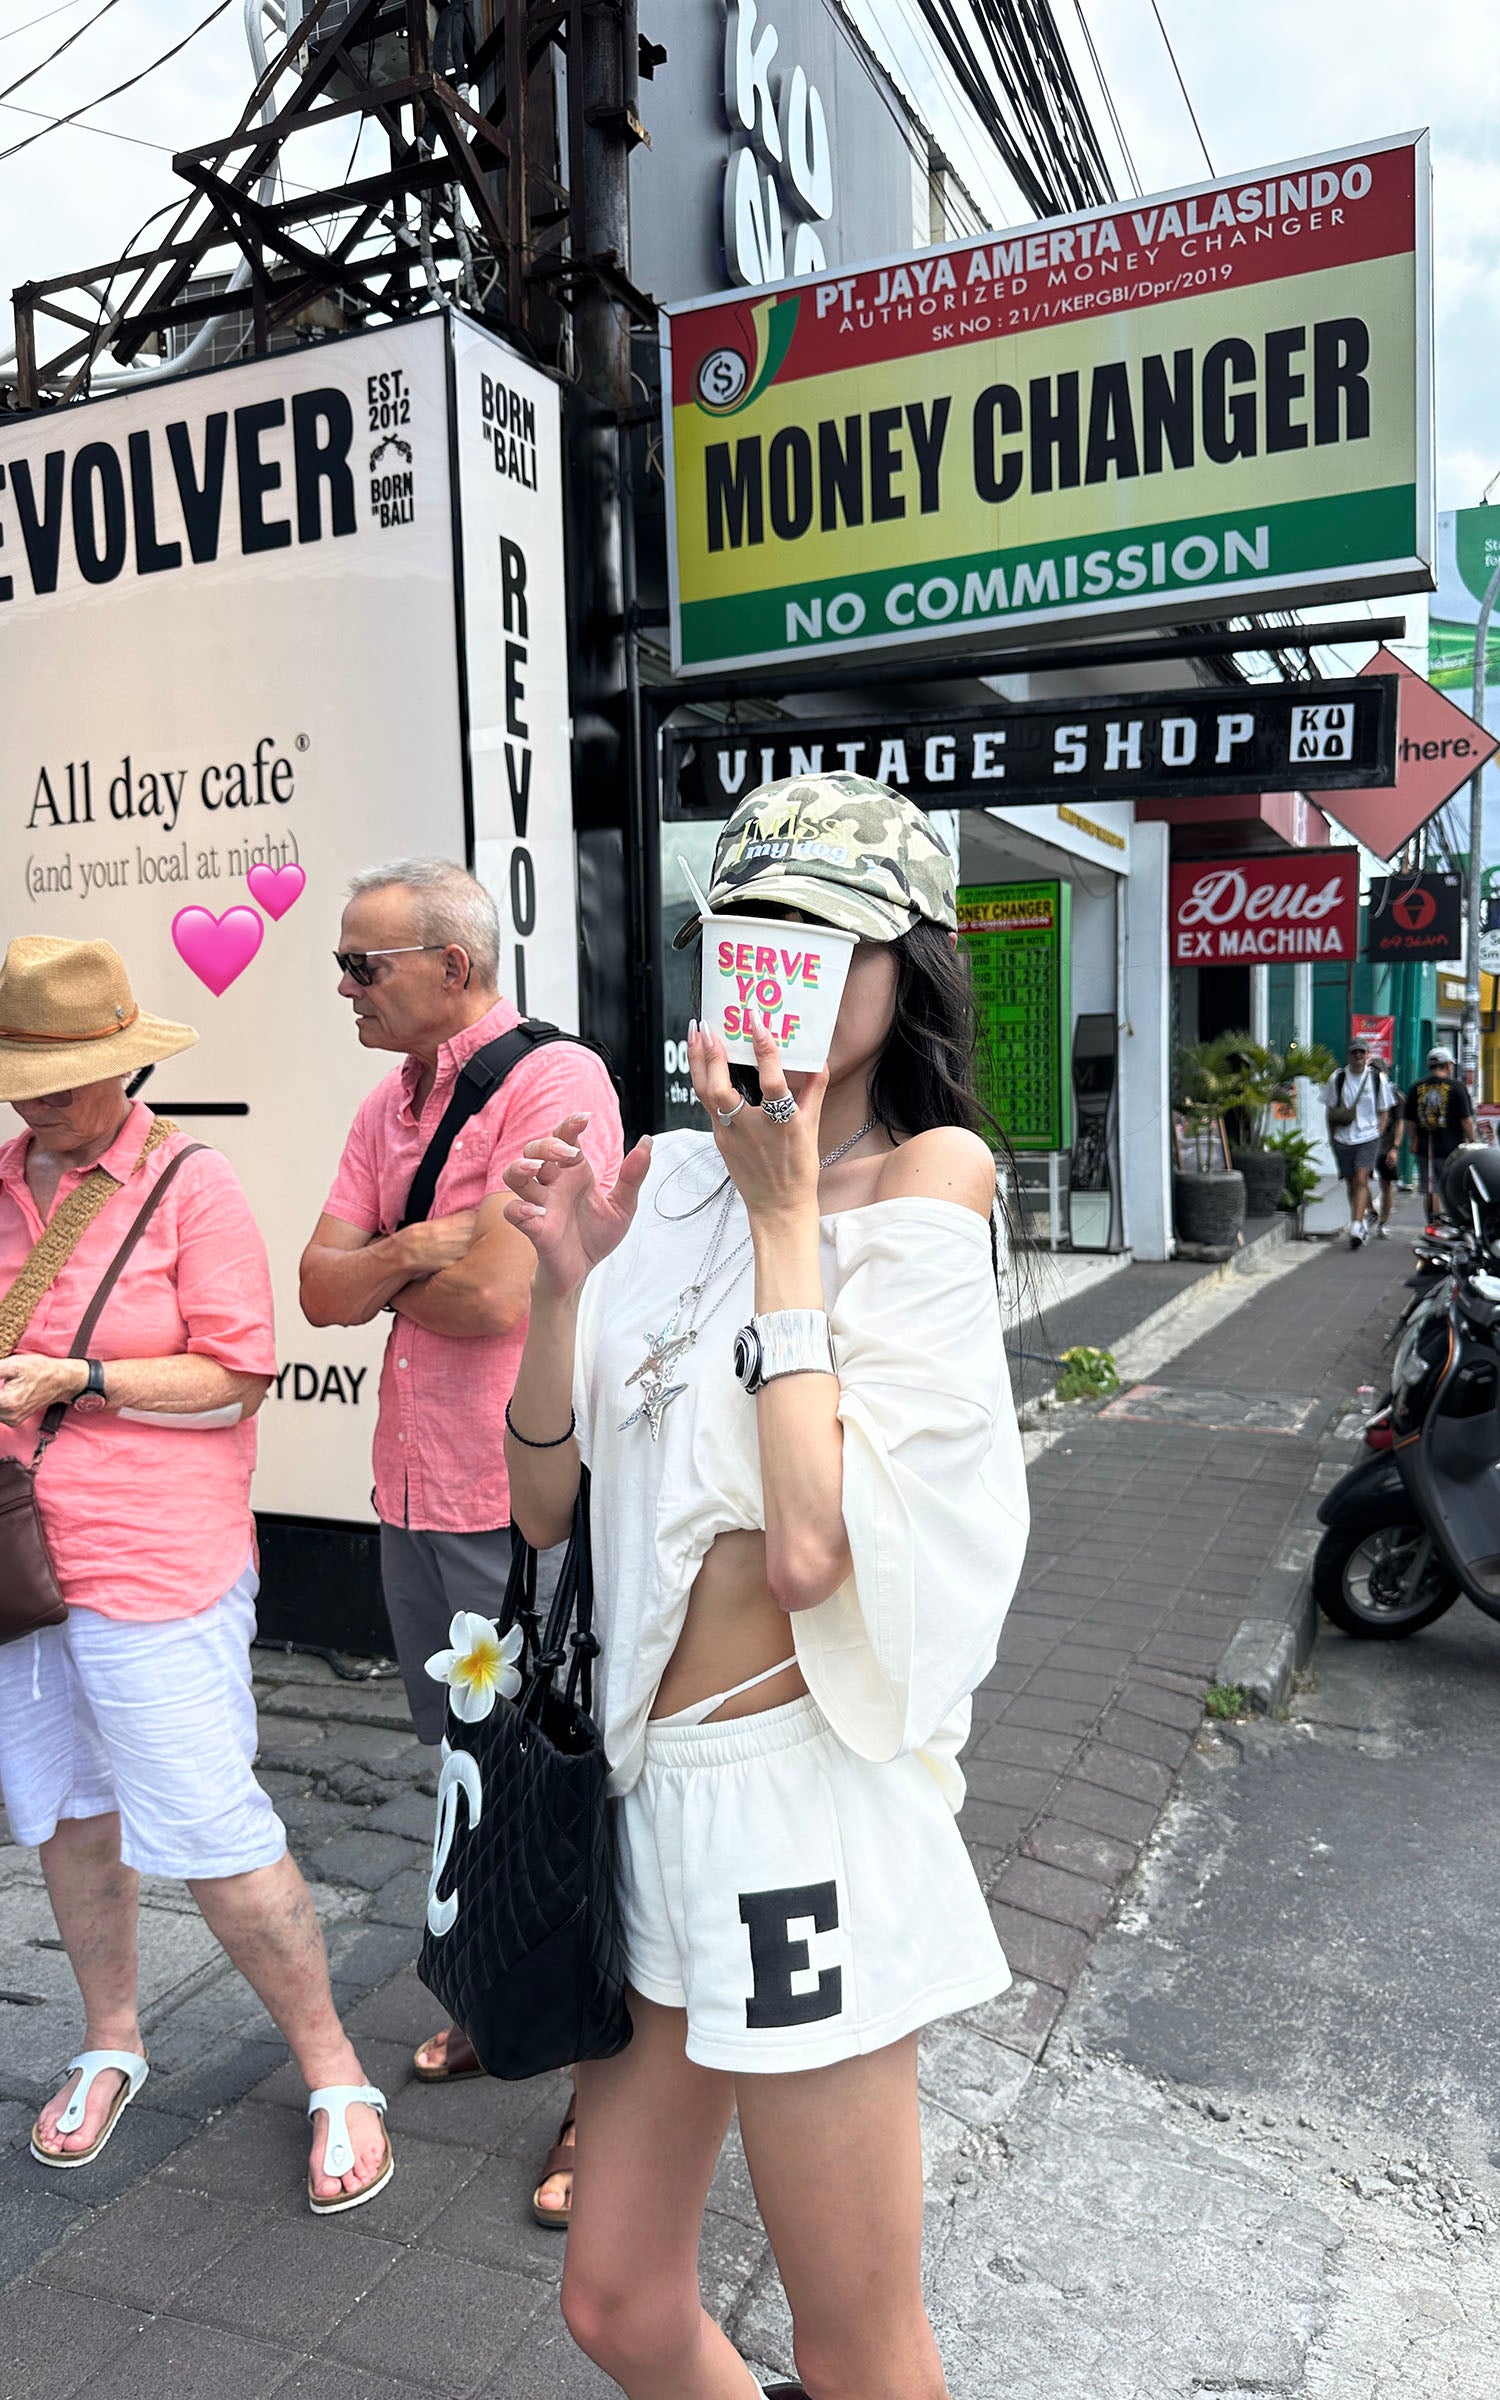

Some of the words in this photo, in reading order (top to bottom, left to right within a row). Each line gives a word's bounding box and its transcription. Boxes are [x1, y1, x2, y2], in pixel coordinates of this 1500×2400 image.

[816, 280, 864, 319] PT.
[874, 258, 956, 306] JAYA
[966, 220, 1121, 285] AMERTA
[1132, 163, 1372, 246] VALASINDO
[839, 278, 1028, 333] AUTHORIZED
[1048, 248, 1159, 288] MONEY
[1181, 209, 1345, 257] CHANGER
[932, 326, 953, 341] SK
[960, 317, 991, 334] NO
[367, 370, 409, 404] EST.
[480, 372, 535, 446] BORN
[369, 399, 410, 431] 2012
[705, 397, 952, 553] MONEY
[972, 317, 1370, 504] CHANGER
[371, 471, 413, 503] BORN
[494, 427, 537, 492] BALI
[0, 388, 357, 601] VOLVER
[380, 498, 414, 528] BALI
[785, 594, 866, 644] NO
[885, 525, 1271, 624] COMMISSION
[717, 731, 1006, 795] VINTAGE
[1053, 714, 1254, 774] SHOP
[1399, 736, 1478, 762] here.
[26, 761, 96, 829] All
[109, 756, 188, 832] day
[26, 853, 72, 902] (and
[79, 858, 130, 899] your
[136, 847, 189, 885] local
[198, 847, 222, 879] at
[746, 843, 789, 859] my
[956, 903, 989, 922] ONEY
[992, 899, 1052, 920] CHANGER
[1178, 867, 1345, 925] Deus
[718, 941, 821, 989] SERVE
[1177, 932, 1212, 958] EX
[1219, 926, 1342, 957] MACHINA
[736, 975, 783, 1014] YO
[738, 1880, 842, 2029] E
